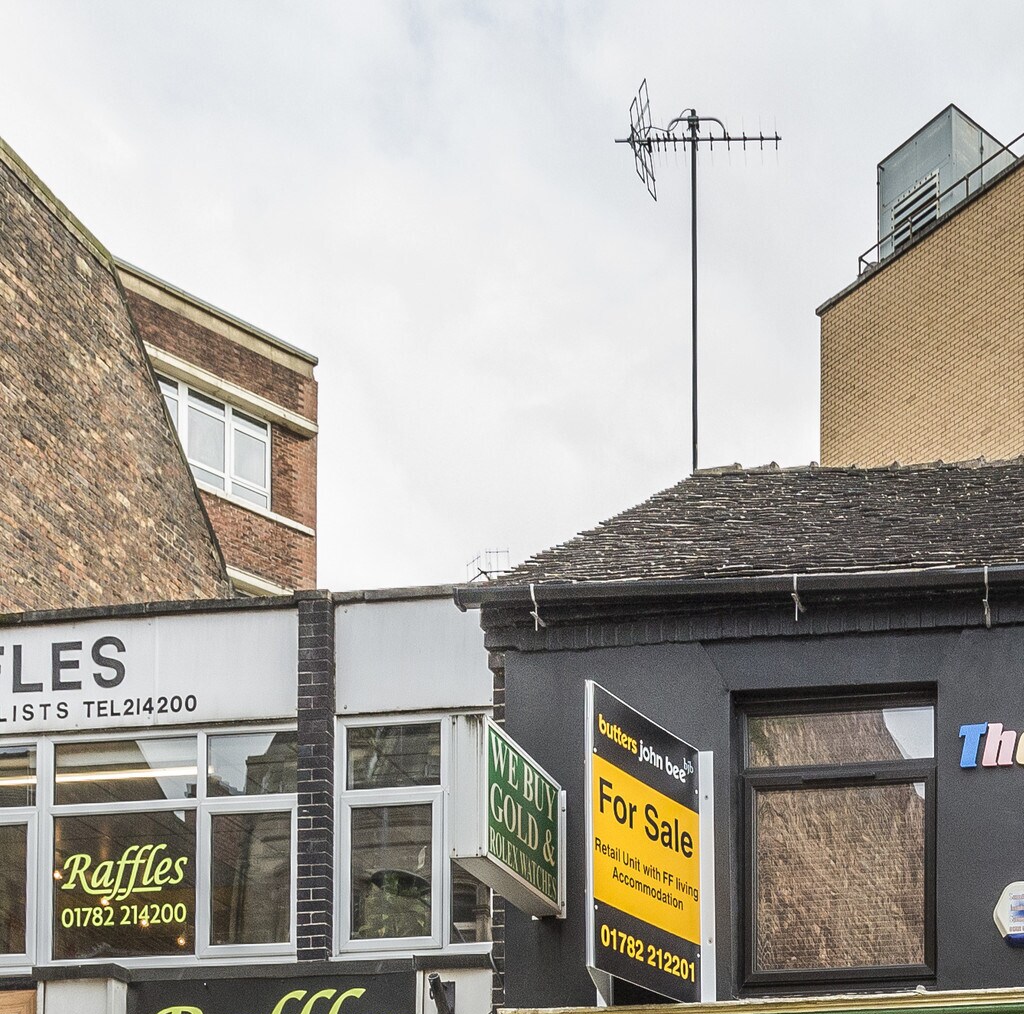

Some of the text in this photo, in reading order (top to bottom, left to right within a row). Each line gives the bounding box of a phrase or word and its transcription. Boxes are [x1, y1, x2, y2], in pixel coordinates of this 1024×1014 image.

[0, 635, 127, 693] LES
[489, 730, 556, 822] WE BUY
[598, 714, 686, 783] butters john bee
[489, 782, 555, 867] GOLD &
[599, 776, 694, 859] For Sale
[61, 843, 188, 901] Raffles
[489, 825, 557, 901] ROLEX WATCHES
[595, 837, 699, 902] Retail Unit with FF living
[612, 866, 684, 911] Accommodation
[61, 904, 187, 928] 01782 214200
[600, 924, 696, 983] 01782 212201
